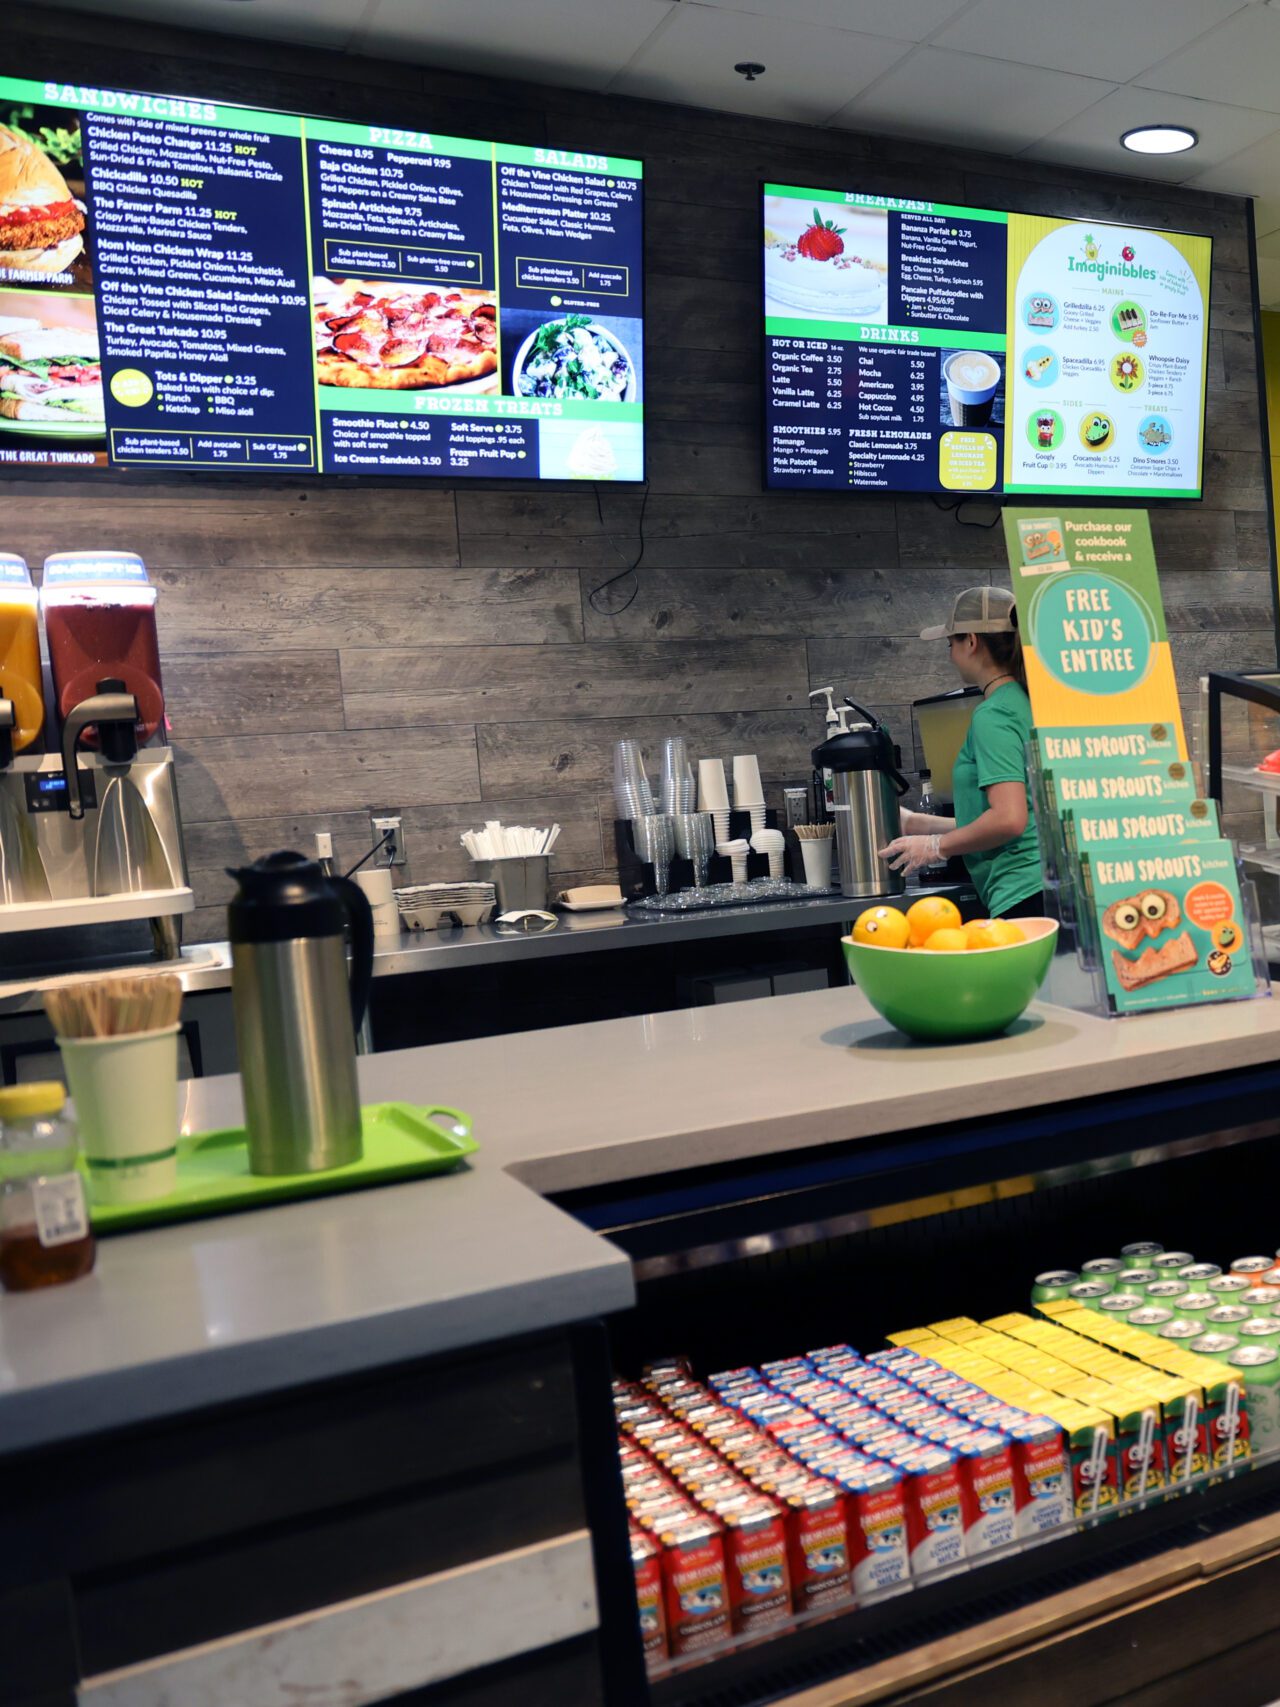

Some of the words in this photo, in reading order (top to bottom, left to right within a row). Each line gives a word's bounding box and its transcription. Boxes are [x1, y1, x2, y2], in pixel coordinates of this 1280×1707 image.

[44, 82, 217, 121] SANDWICHES
[87, 126, 130, 141] Chicken
[132, 131, 162, 144] Pesto
[163, 135, 203, 150] Chango
[204, 140, 232, 153] 11.25
[234, 144, 257, 156] HOT
[369, 126, 433, 150] PIZZA
[318, 143, 353, 157] Cheese
[354, 148, 374, 159] 8.95
[386, 152, 432, 166] Pepperoni
[433, 158, 451, 168] 9.95
[534, 148, 608, 171] SALADS
[91, 166, 148, 183] Chickadilla
[150, 173, 179, 186] 10.50
[180, 177, 204, 188] HOT
[319, 160, 340, 172] Baja
[341, 162, 378, 175] Chicken
[379, 167, 404, 178] 10.75
[92, 180, 114, 192] BBQ
[115, 183, 151, 195] Chicken
[152, 187, 197, 200] Quesadilla
[93, 196, 114, 208] The
[116, 198, 153, 212] Farmer
[154, 202, 182, 215] Parm
[184, 206, 212, 218] 11.25
[214, 210, 237, 220] HOT
[845, 192, 935, 212] BREAKFAST
[501, 201, 561, 216] Mediterranean
[561, 208, 588, 219] Platter
[589, 211, 611, 221] 10.25
[901, 223, 928, 233] Bananza
[928, 226, 950, 235] Parfait
[958, 229, 971, 238] 3.75
[97, 238, 124, 250] Nom
[125, 240, 152, 253] Nom
[153, 243, 194, 256] Chicken
[195, 247, 224, 260] Wrap
[225, 250, 253, 262] 11.25
[901, 253, 931, 264] Breakfast
[932, 256, 968, 267] Sandwiches
[8, 268, 45, 282] FARMER
[46, 271, 73, 284] PARM
[1067, 256, 1157, 281] Imaginibbles
[100, 281, 119, 291] Off
[120, 282, 138, 293] the
[139, 283, 163, 295] Vine
[164, 285, 205, 298] Chicken
[205, 288, 232, 300] Salad
[233, 291, 279, 304] Sandwich
[280, 294, 306, 306] 10.95
[104, 321, 125, 333] The
[126, 323, 156, 335] Great
[156, 325, 199, 337] Turkado
[200, 328, 227, 339] 10.95
[860, 326, 920, 342] DRINKS
[772, 338, 791, 347] HOT
[792, 340, 805, 348] OR
[806, 340, 828, 350] ICED
[771, 351, 799, 361] Organic
[800, 353, 823, 362] Coffee
[826, 354, 842, 363] 3.50
[154, 370, 177, 381] Tots
[178, 372, 188, 382] &
[189, 372, 223, 384] Dipper
[235, 375, 256, 385] 3.25
[858, 368, 881, 377] Mocha
[909, 371, 924, 380] 6.25
[772, 386, 795, 395] Vanilla
[796, 388, 814, 396] Latte
[826, 389, 842, 398] 6.25
[858, 380, 894, 389] Americano
[910, 382, 924, 391] 3.95
[858, 391, 896, 400] Cappuccino
[910, 394, 924, 402] 4.95
[414, 396, 488, 413] FROZEN
[494, 398, 563, 416] TREATS
[332, 417, 375, 428] Smoothie
[375, 419, 398, 429] Float
[409, 420, 430, 430] 4.50
[773, 425, 826, 435] SMOOTHIES
[827, 427, 841, 435] 5.95
[849, 429, 877, 437] FRESH
[879, 430, 931, 439] LEMONADES
[848, 440, 870, 448] Classic
[871, 441, 903, 449] Lemonade
[904, 442, 917, 450] 3.75
[19, 452, 47, 463] GREAT
[50, 453, 95, 464] TURKADO
[334, 453, 348, 463] Ice
[348, 453, 378, 463] Cream
[379, 454, 421, 464] Sandwich
[422, 456, 441, 465] 3.50
[853, 461, 884, 469] Strawberry
[1065, 521, 1112, 533] Purchase
[1114, 522, 1131, 532] our
[1075, 536, 1126, 547] cookbook
[1075, 551, 1084, 562] &
[1086, 551, 1123, 562] receive
[1125, 553, 1132, 562] a
[1065, 589, 1112, 613] FREE
[1062, 618, 1123, 642] KID'S
[1060, 648, 1135, 673] ENTREE
[1045, 736, 1082, 759] BEAN
[1084, 734, 1146, 758] SPROUTS
[1060, 777, 1098, 801] BEAN
[1100, 775, 1163, 799] SPROUTS
[1081, 817, 1119, 842] BEAN
[1122, 814, 1185, 840] SPROUTS
[1096, 860, 1135, 885] BEAN
[1138, 855, 1202, 880] SPROUTS
